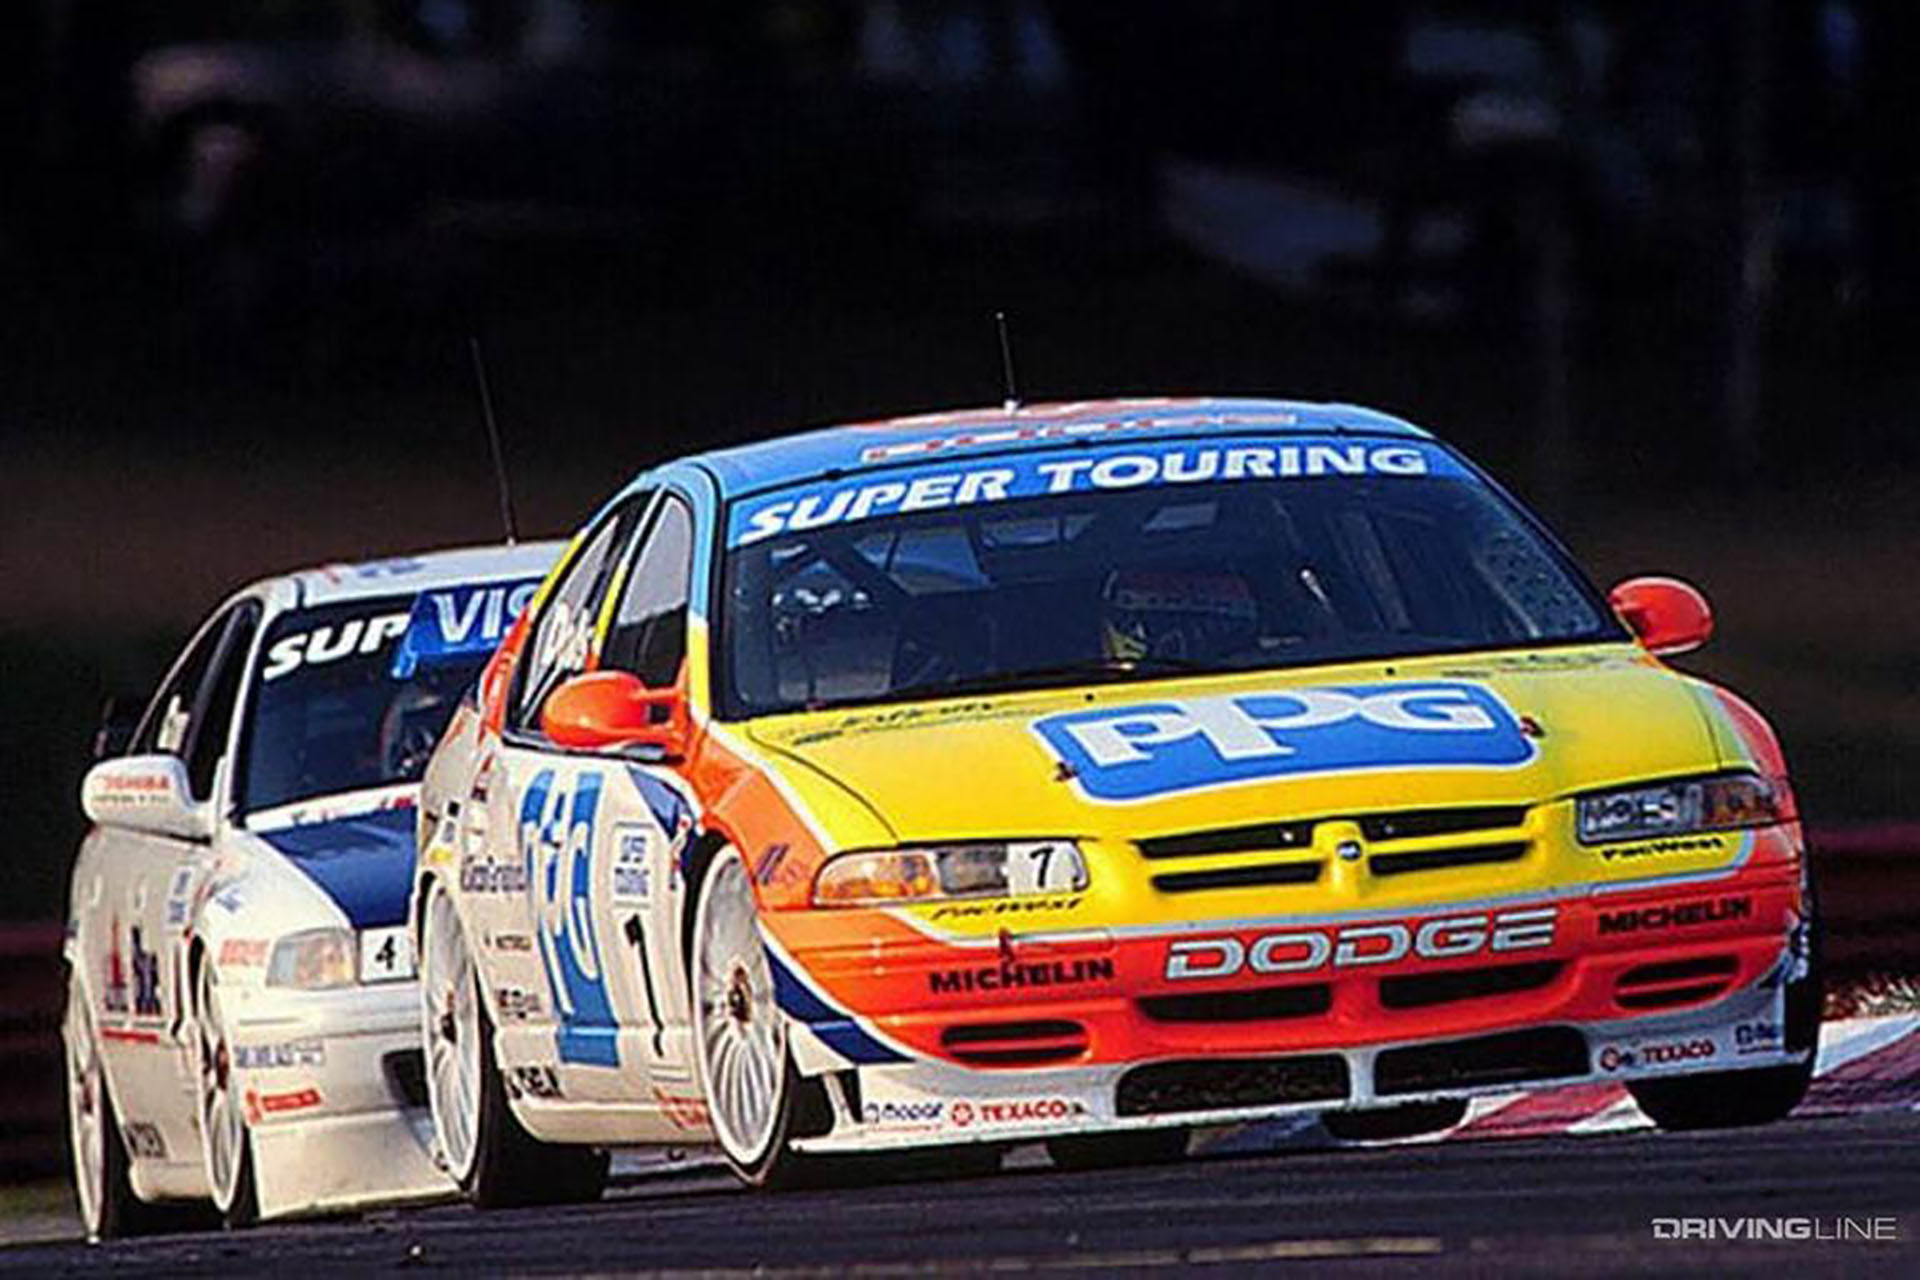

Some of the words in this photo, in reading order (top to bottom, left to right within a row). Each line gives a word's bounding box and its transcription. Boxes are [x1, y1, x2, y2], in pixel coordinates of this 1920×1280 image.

[739, 466, 1015, 545] SUPER
[1039, 446, 1431, 497] TOURING
[1063, 682, 1500, 768] PPG
[1026, 846, 1055, 889] 7
[1598, 896, 1752, 936] MICHELIN
[374, 935, 397, 971] 4
[1165, 908, 1558, 980] DODGE
[929, 959, 1115, 994] MICHELIN
[980, 1100, 1069, 1122] TEXACO
